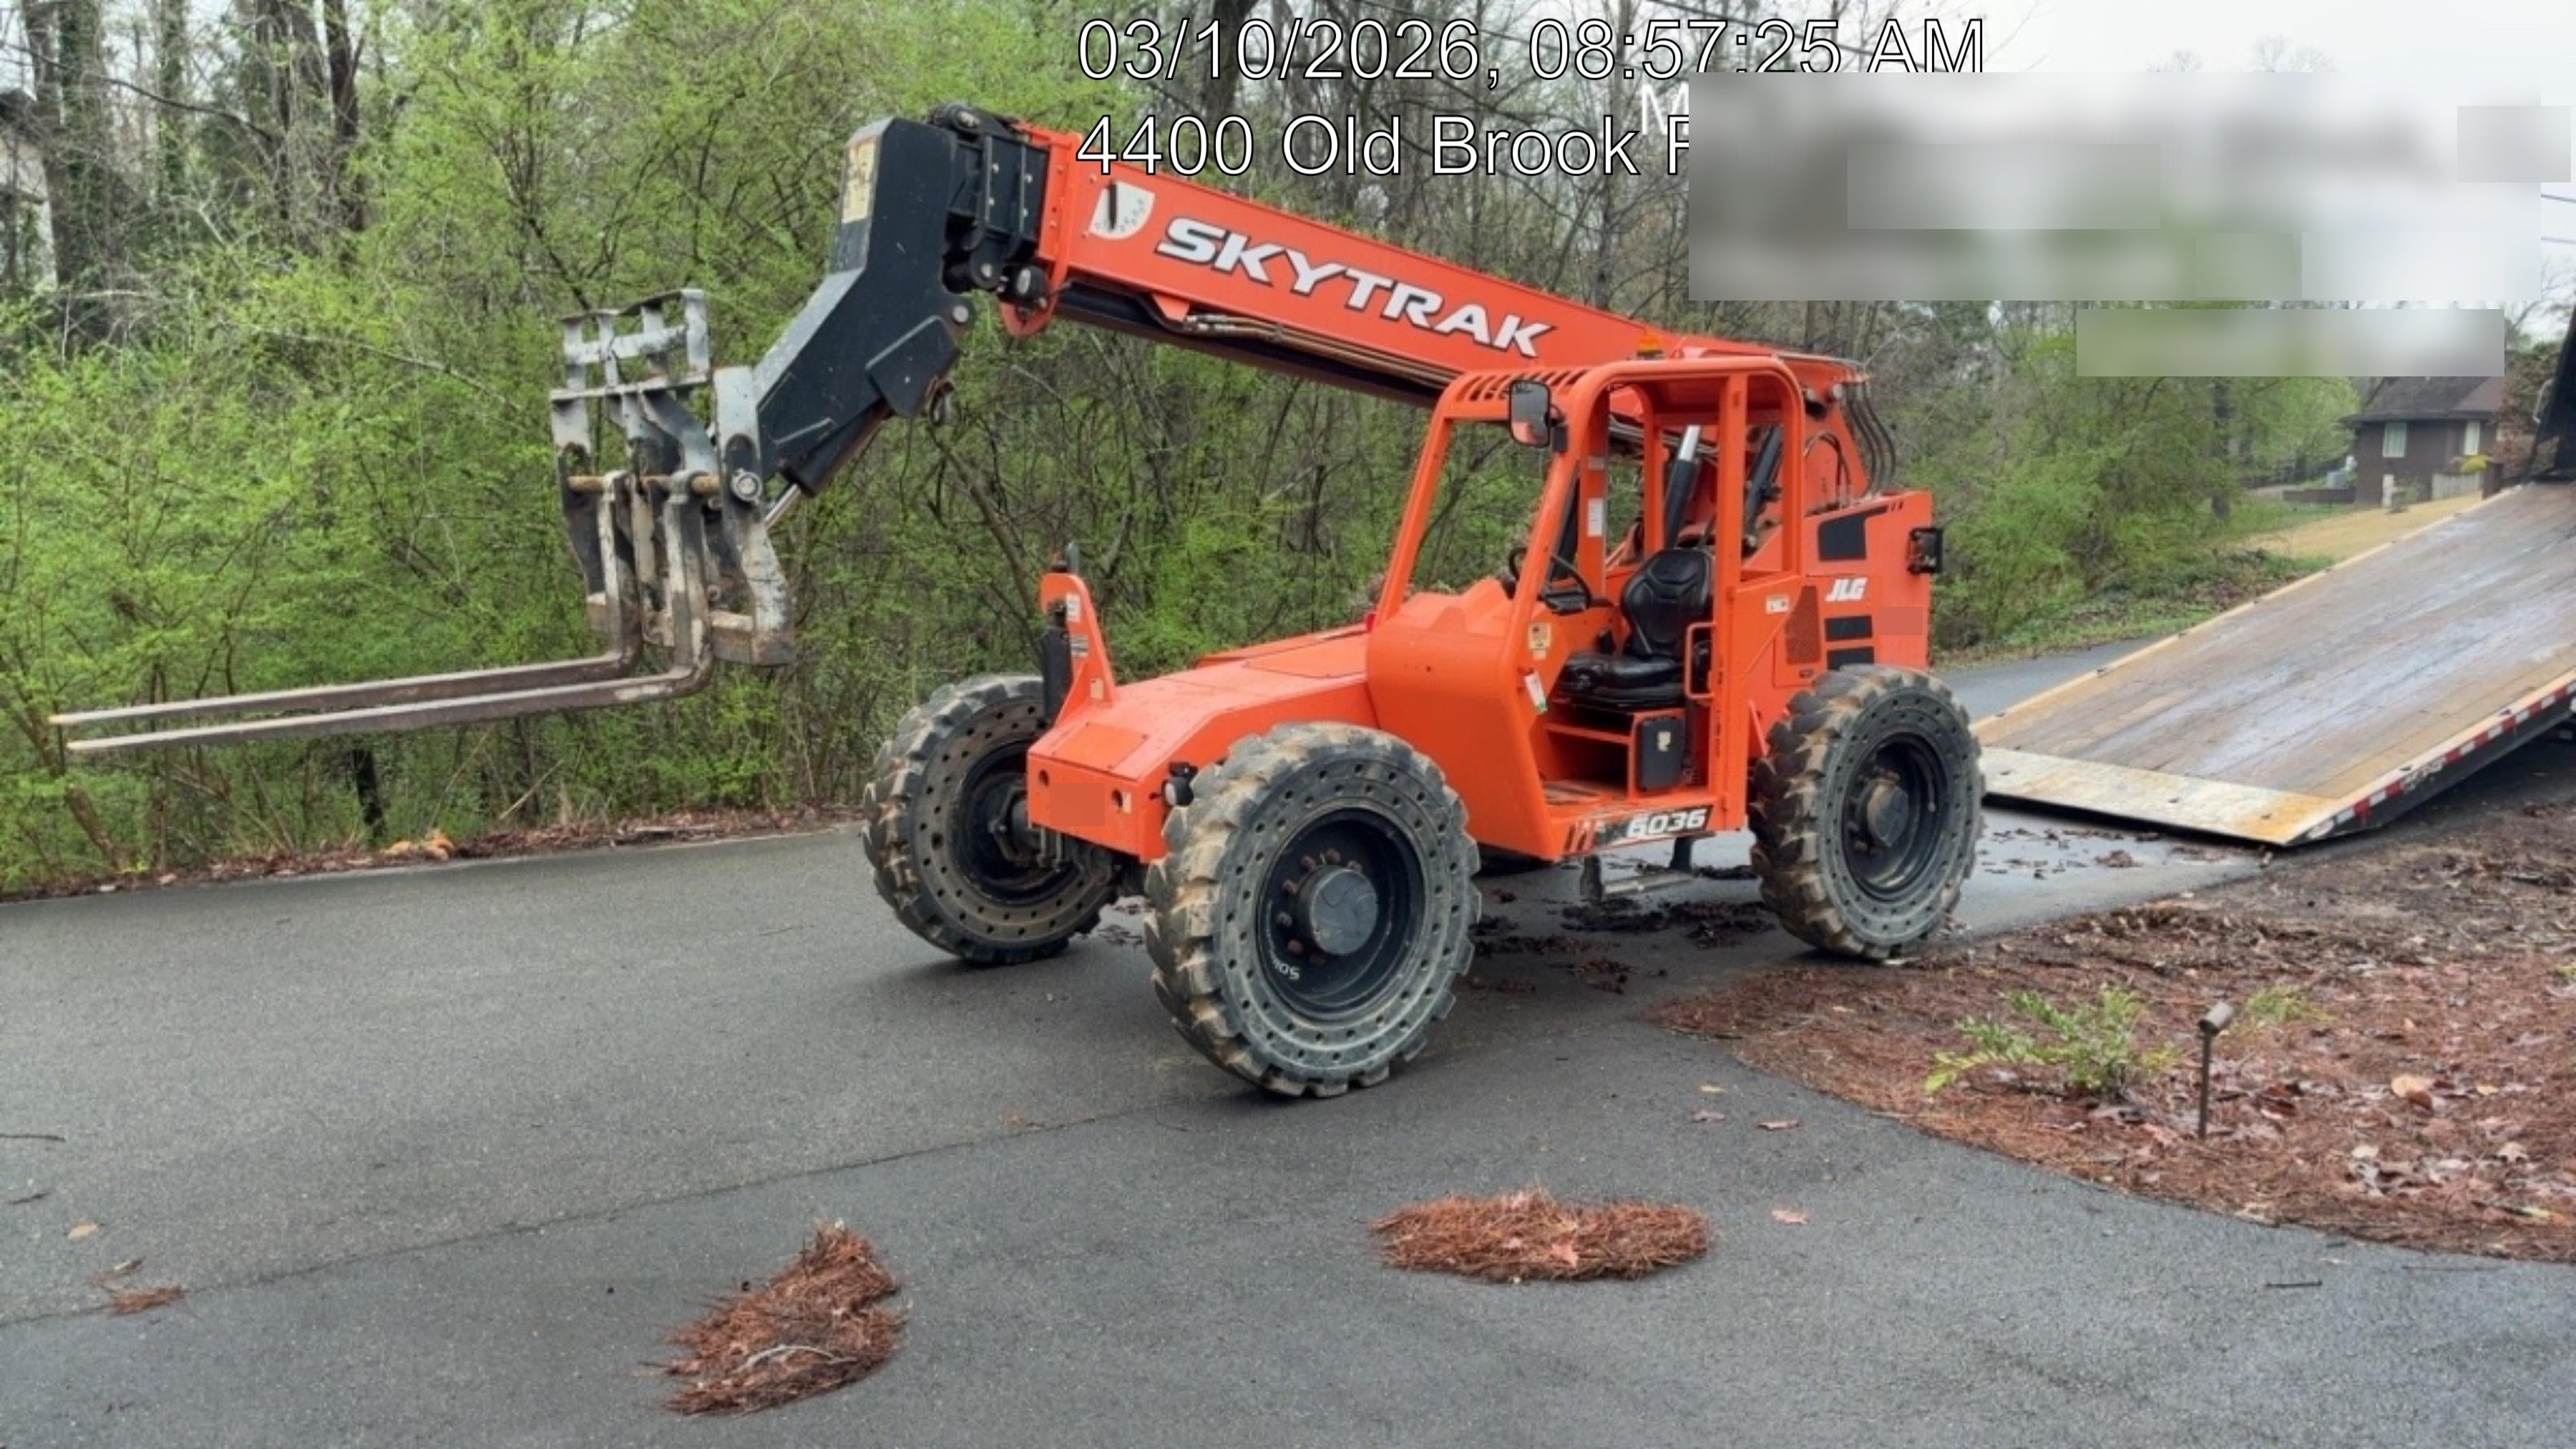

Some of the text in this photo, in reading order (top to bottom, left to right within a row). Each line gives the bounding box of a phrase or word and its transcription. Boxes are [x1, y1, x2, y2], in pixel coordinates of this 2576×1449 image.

[1154, 215, 1554, 358] SKYTRAK
[1825, 577, 1868, 602] JLG
[1627, 808, 1709, 838] 6036
